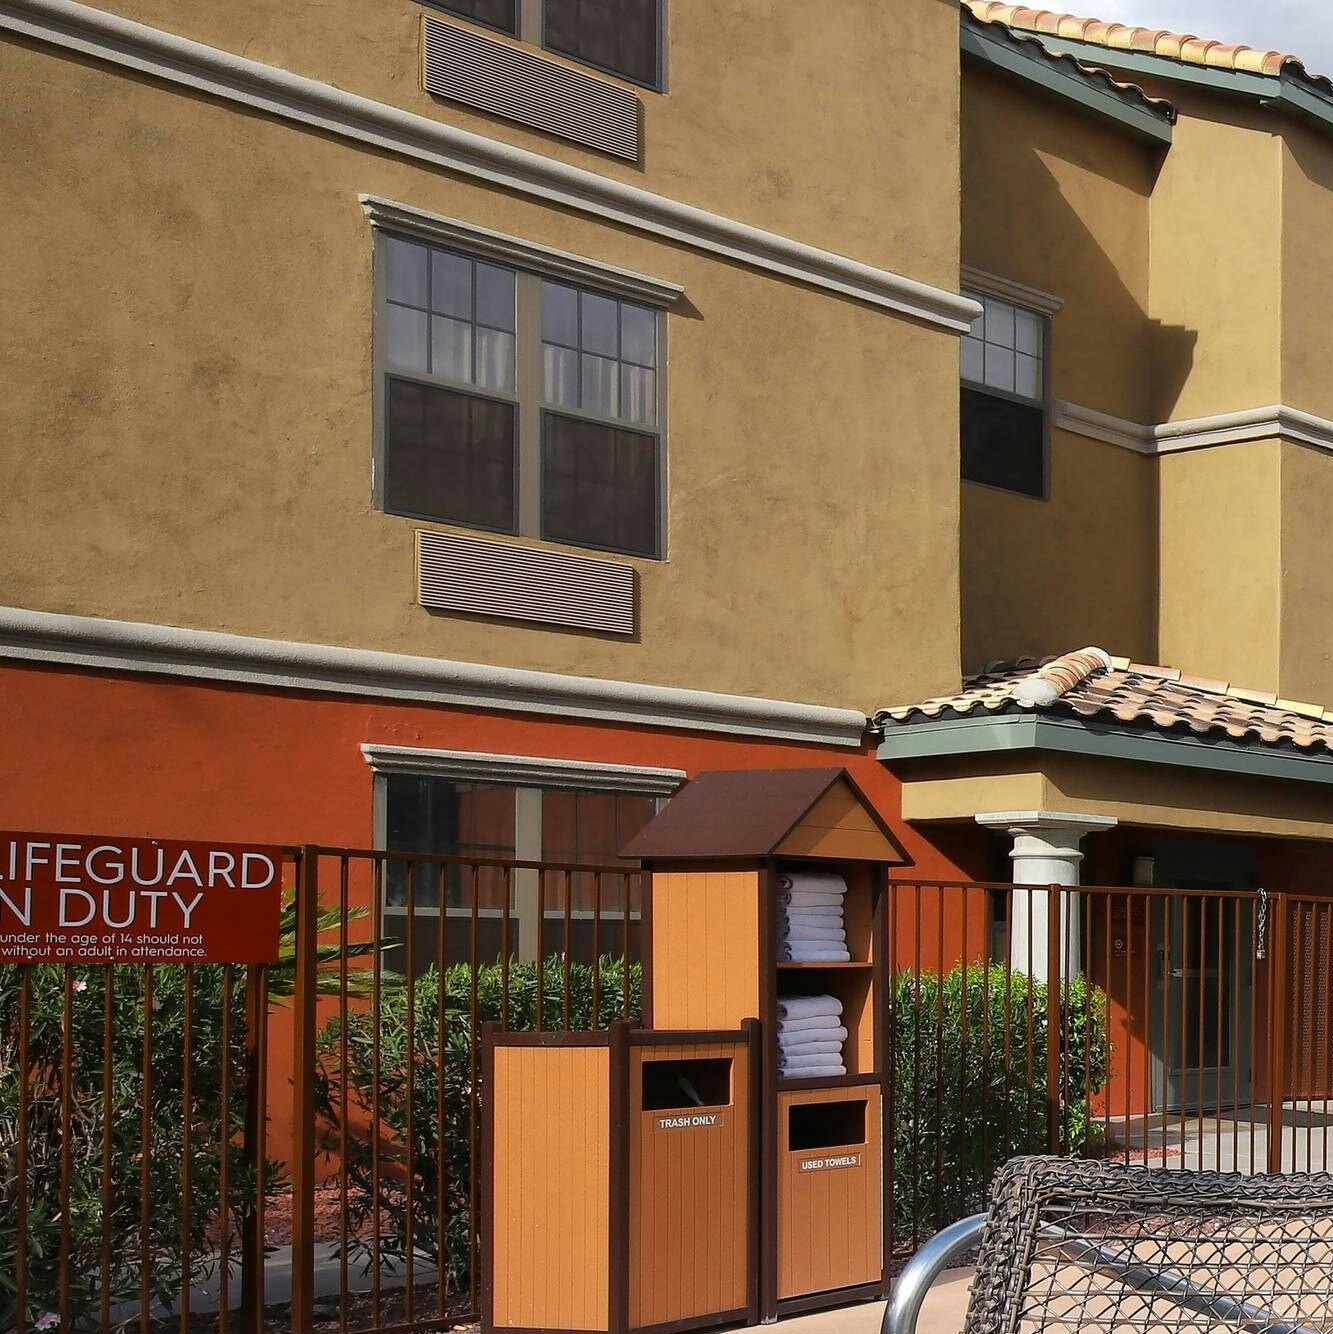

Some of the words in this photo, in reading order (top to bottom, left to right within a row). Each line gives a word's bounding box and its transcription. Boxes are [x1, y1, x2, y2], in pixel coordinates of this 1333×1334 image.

[0, 841, 275, 889] IFEGUARD
[59, 888, 204, 929] DUTY
[0, 932, 40, 943] under
[45, 932, 67, 943] the
[71, 934, 97, 946] age
[102, 933, 115, 944] of
[120, 934, 132, 944] 14
[136, 934, 179, 944] should
[182, 934, 204, 944] not
[1, 945, 52, 957] without
[56, 947, 74, 957] an
[78, 945, 112, 957] adult
[117, 946, 127, 957] in
[132, 946, 207, 957] attendance.
[659, 1117, 691, 1129] TRASH
[692, 1115, 717, 1126] ONLY
[801, 1159, 824, 1170] USED
[825, 1156, 857, 1168] TOWELS
